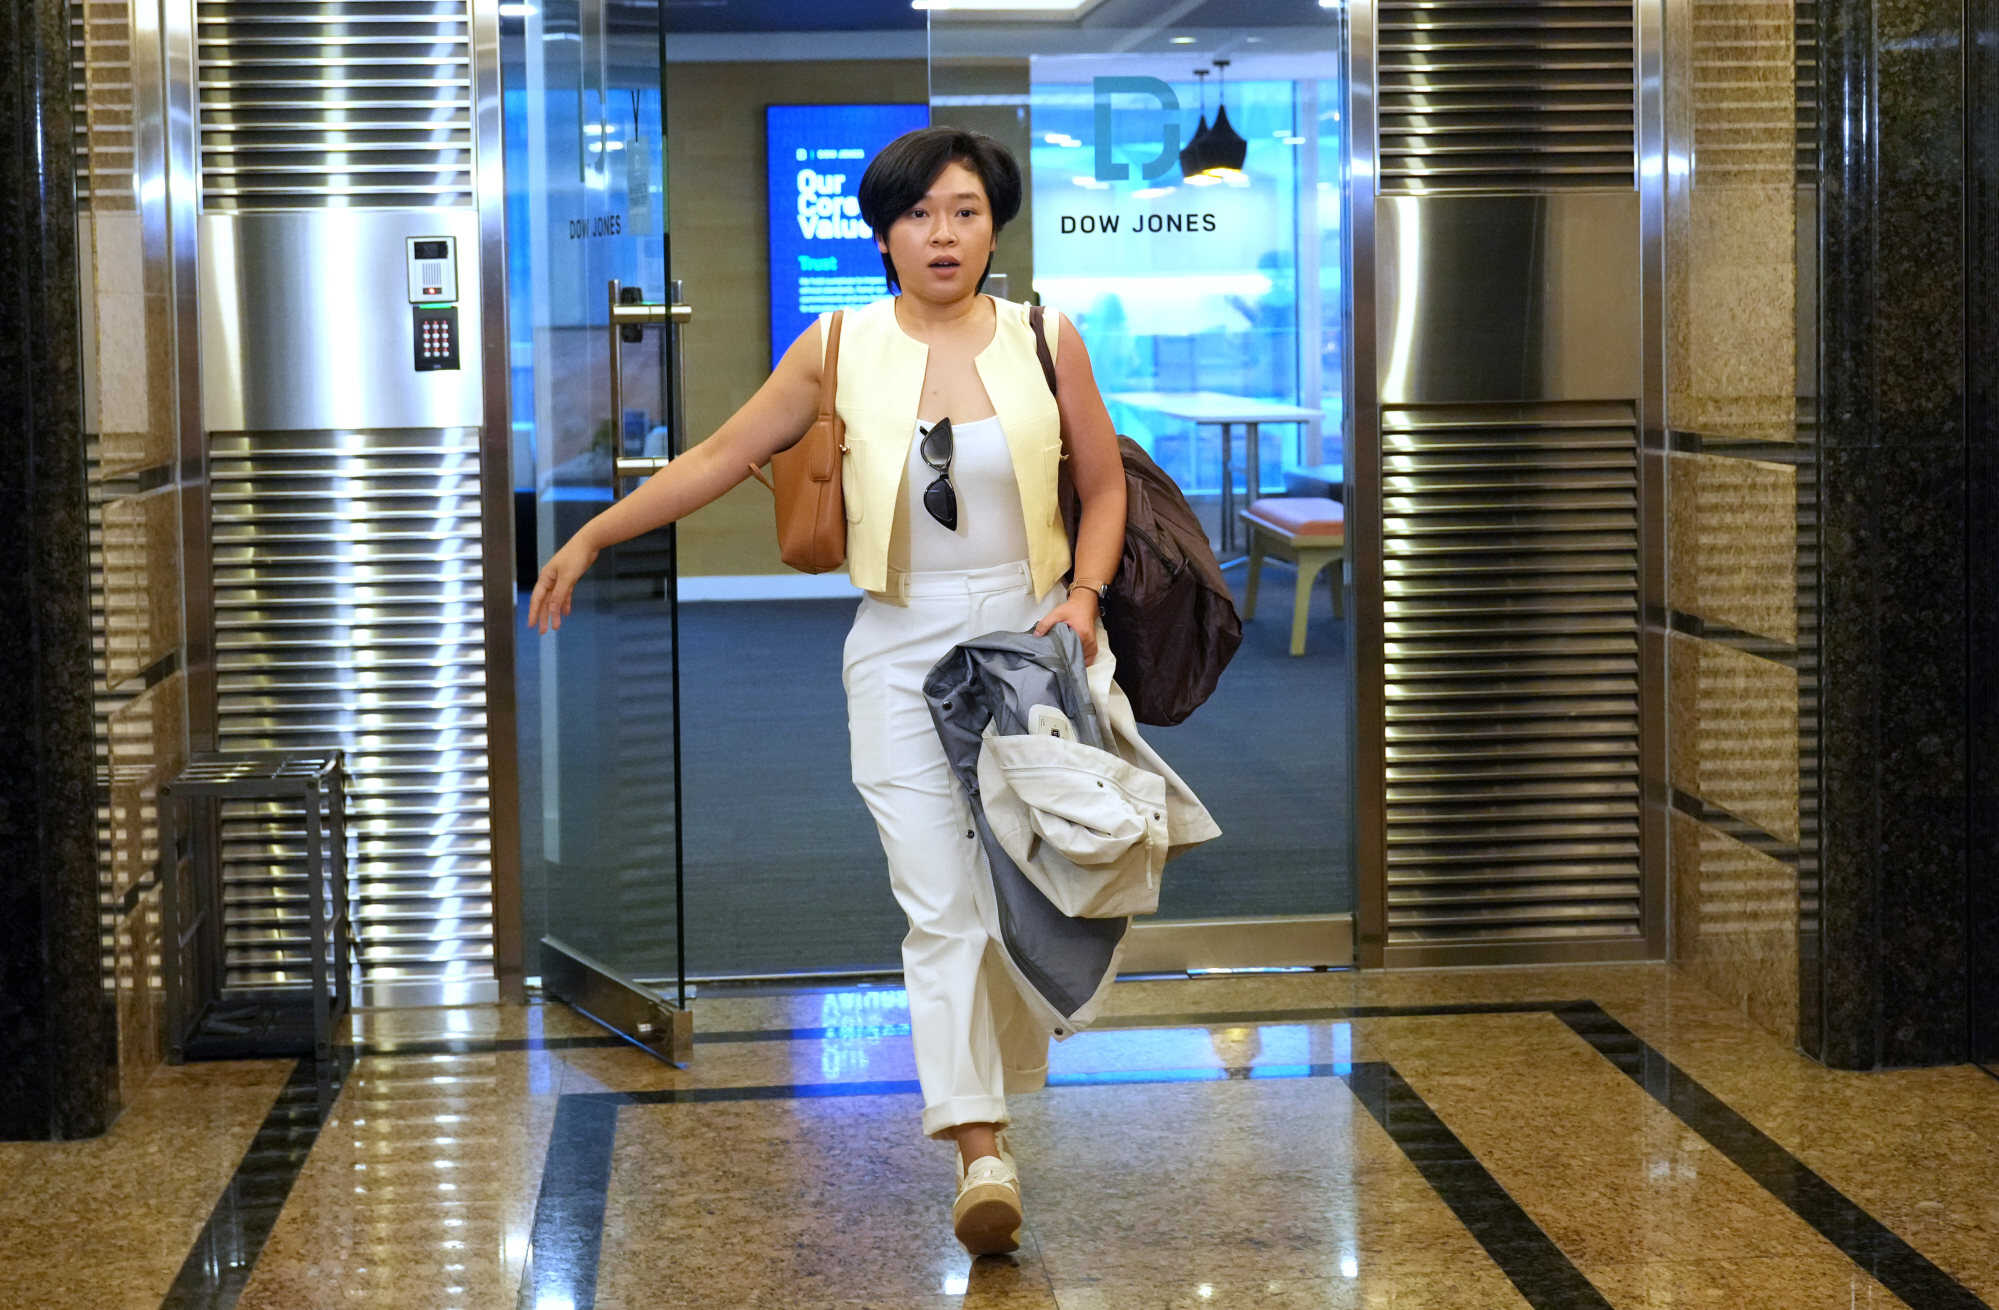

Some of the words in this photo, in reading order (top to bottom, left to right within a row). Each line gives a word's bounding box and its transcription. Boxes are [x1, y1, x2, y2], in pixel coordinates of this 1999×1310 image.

[797, 168, 846, 195] Our
[797, 193, 861, 217] Core
[569, 216, 589, 240] DOW
[592, 213, 621, 237] JONES
[1061, 214, 1120, 234] DOW
[1132, 213, 1216, 233] JONES
